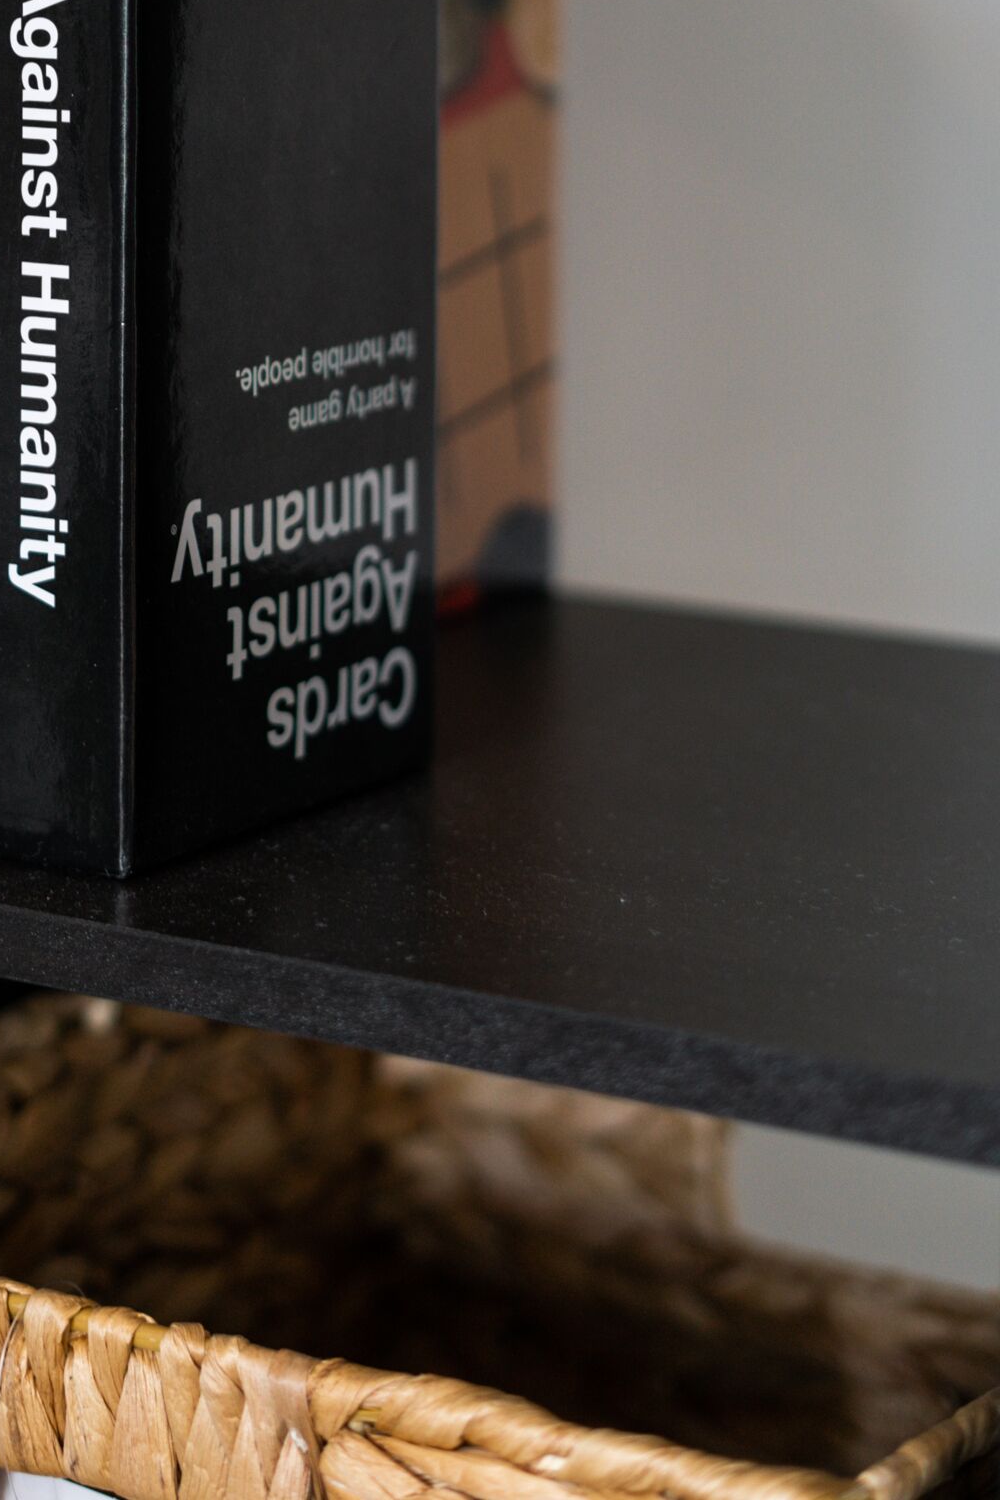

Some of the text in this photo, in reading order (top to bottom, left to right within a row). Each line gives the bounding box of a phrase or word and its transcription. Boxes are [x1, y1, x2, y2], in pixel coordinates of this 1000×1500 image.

[236, 328, 415, 397] for horrible people.
[288, 376, 415, 431] A party game
[8, 261, 70, 609] Humanity
[226, 543, 417, 681] Against
[266, 646, 418, 759] Cards
